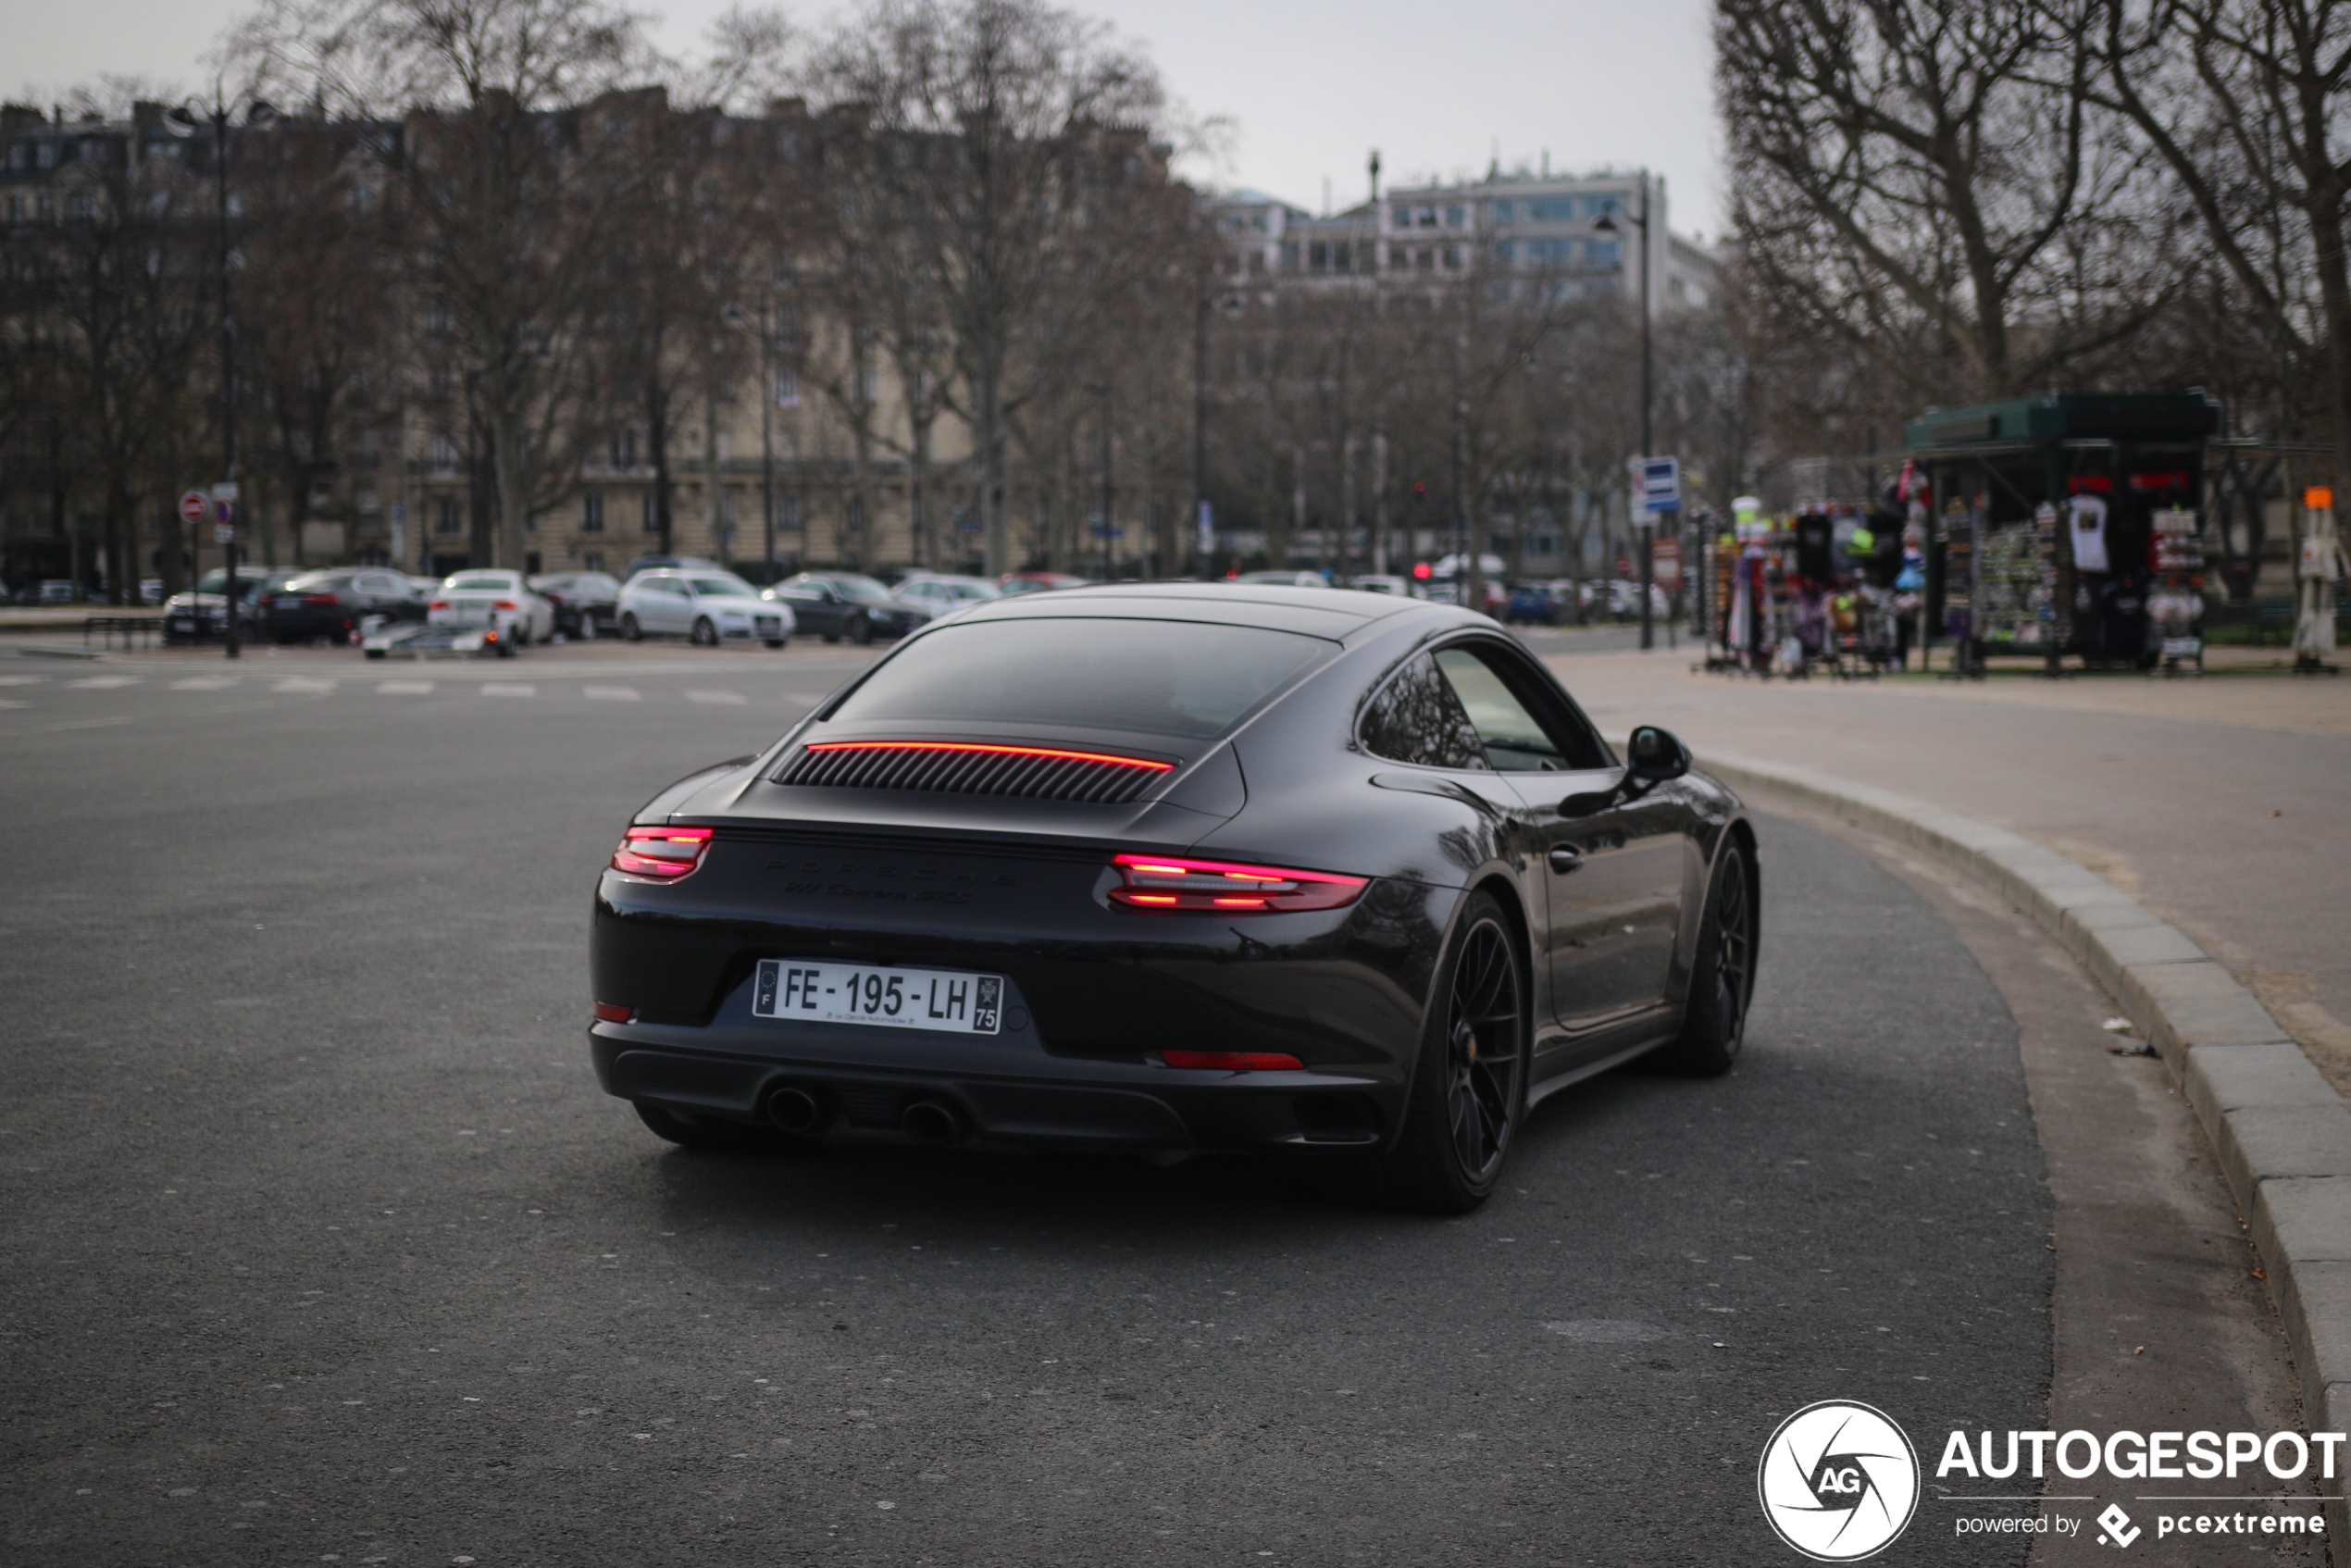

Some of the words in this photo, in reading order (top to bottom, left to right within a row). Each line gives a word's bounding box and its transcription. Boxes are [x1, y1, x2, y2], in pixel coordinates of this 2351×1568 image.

[764, 861, 1017, 886] PORSCHE
[761, 994, 770, 1005] F
[976, 1008, 996, 1028] 75
